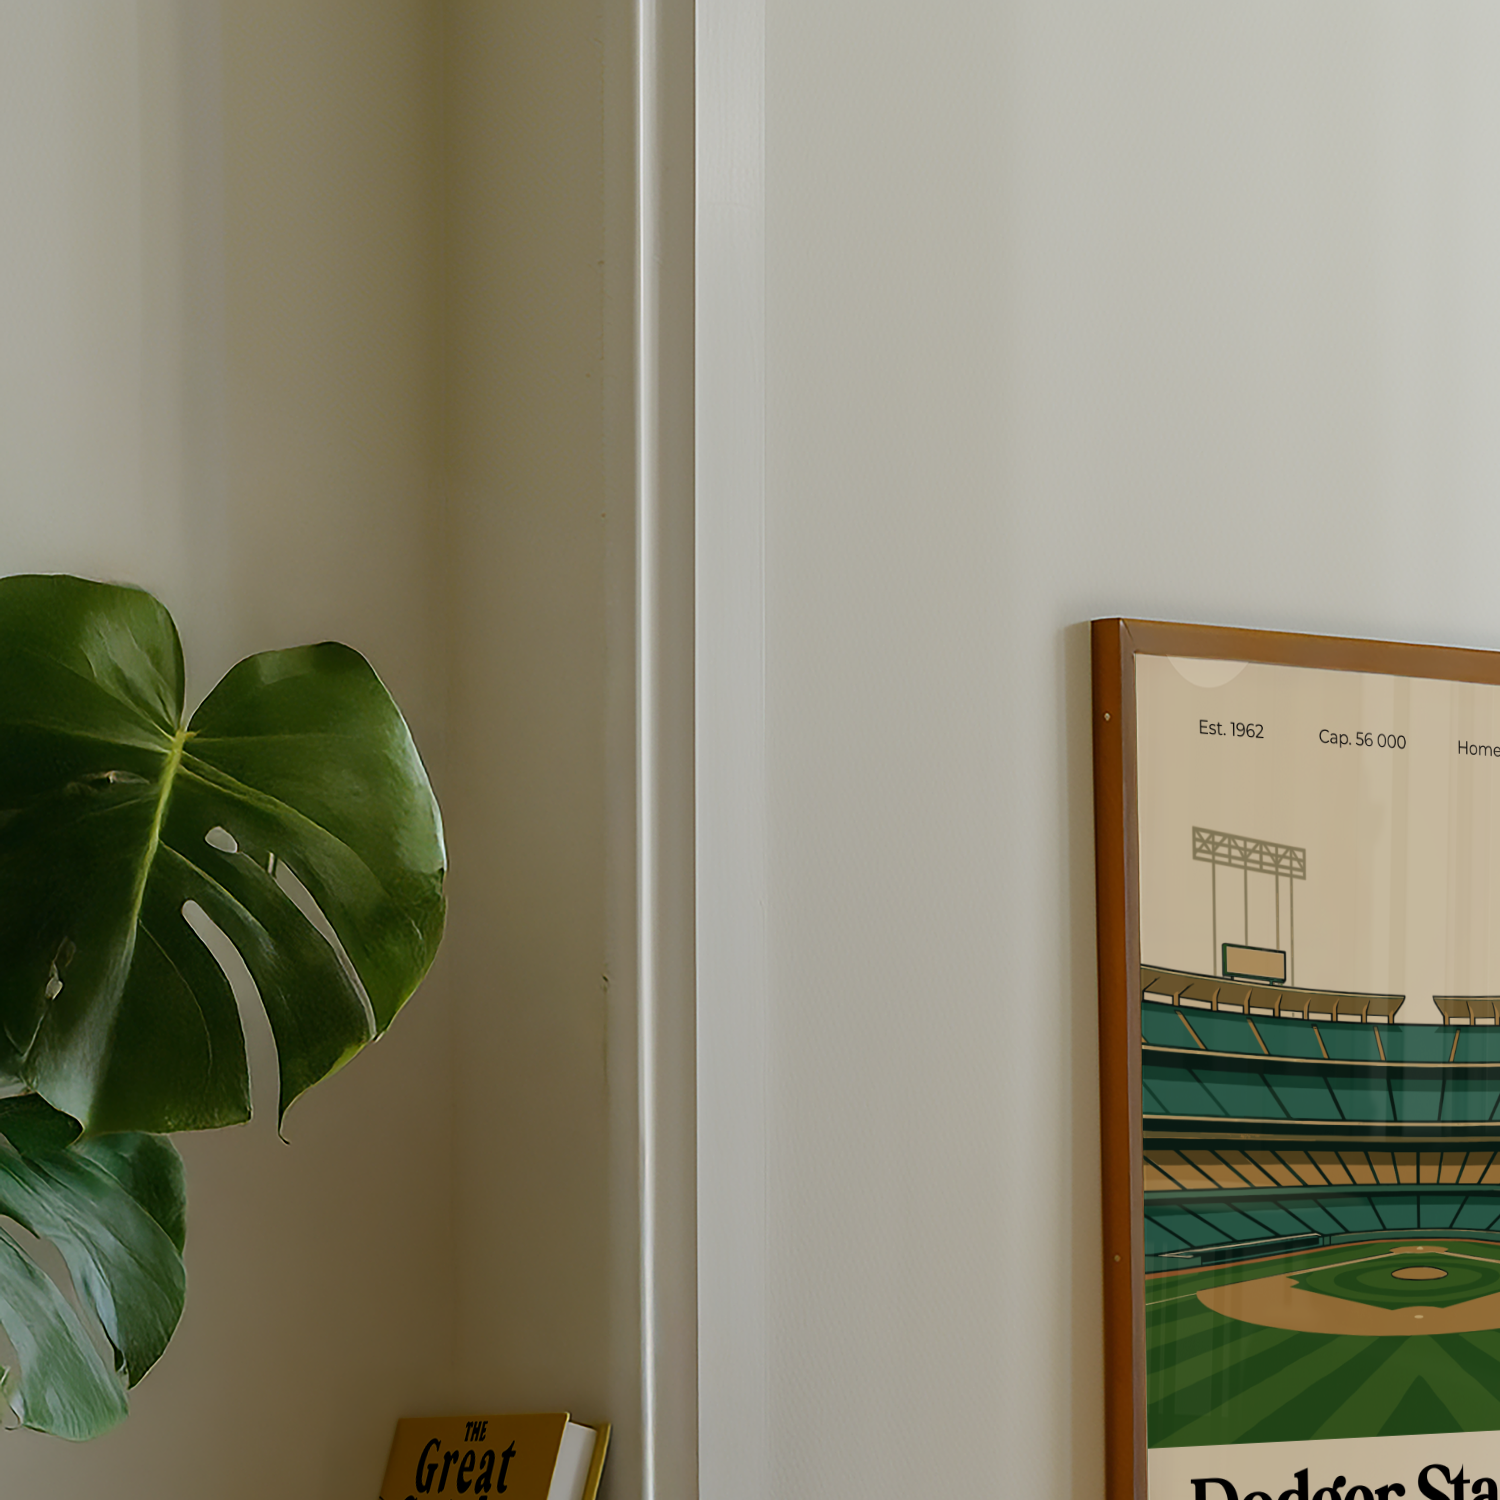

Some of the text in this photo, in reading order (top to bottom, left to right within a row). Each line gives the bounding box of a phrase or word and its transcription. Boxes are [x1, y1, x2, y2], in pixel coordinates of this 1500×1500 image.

[1199, 719, 1264, 739] Est. 1962
[1319, 729, 1406, 749] Cap. 56 000
[1458, 739, 1500, 757] Home
[464, 1420, 489, 1442] THE
[416, 1437, 517, 1495] Great
